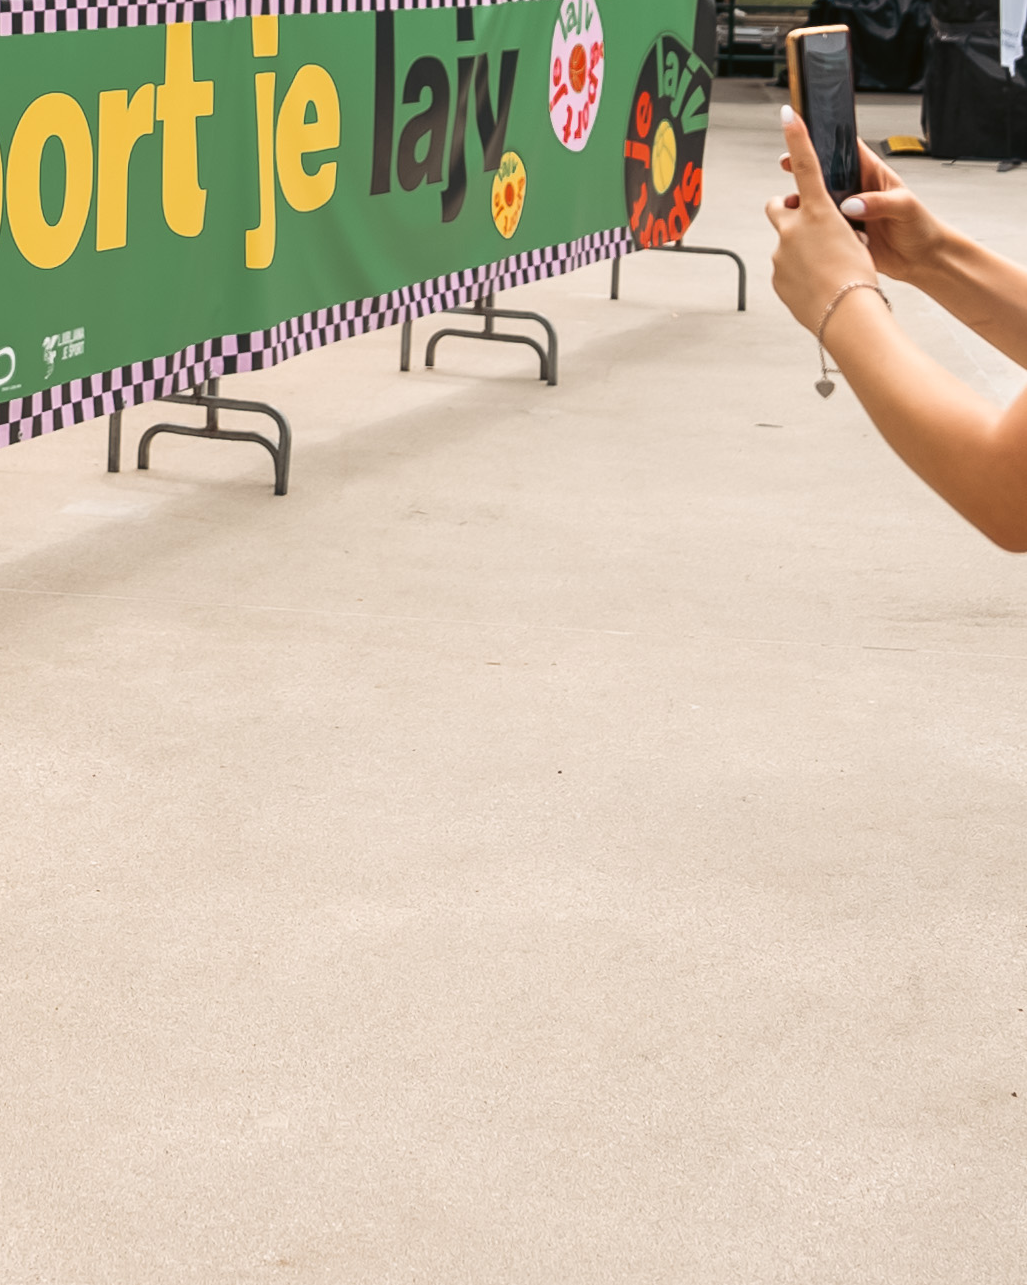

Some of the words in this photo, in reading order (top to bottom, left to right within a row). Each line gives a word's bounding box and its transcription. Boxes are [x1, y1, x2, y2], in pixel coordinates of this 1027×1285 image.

[624, 90, 653, 169] je
[655, 35, 708, 134] lajv
[244, 15, 341, 270] je
[369, 6, 520, 223] lajv
